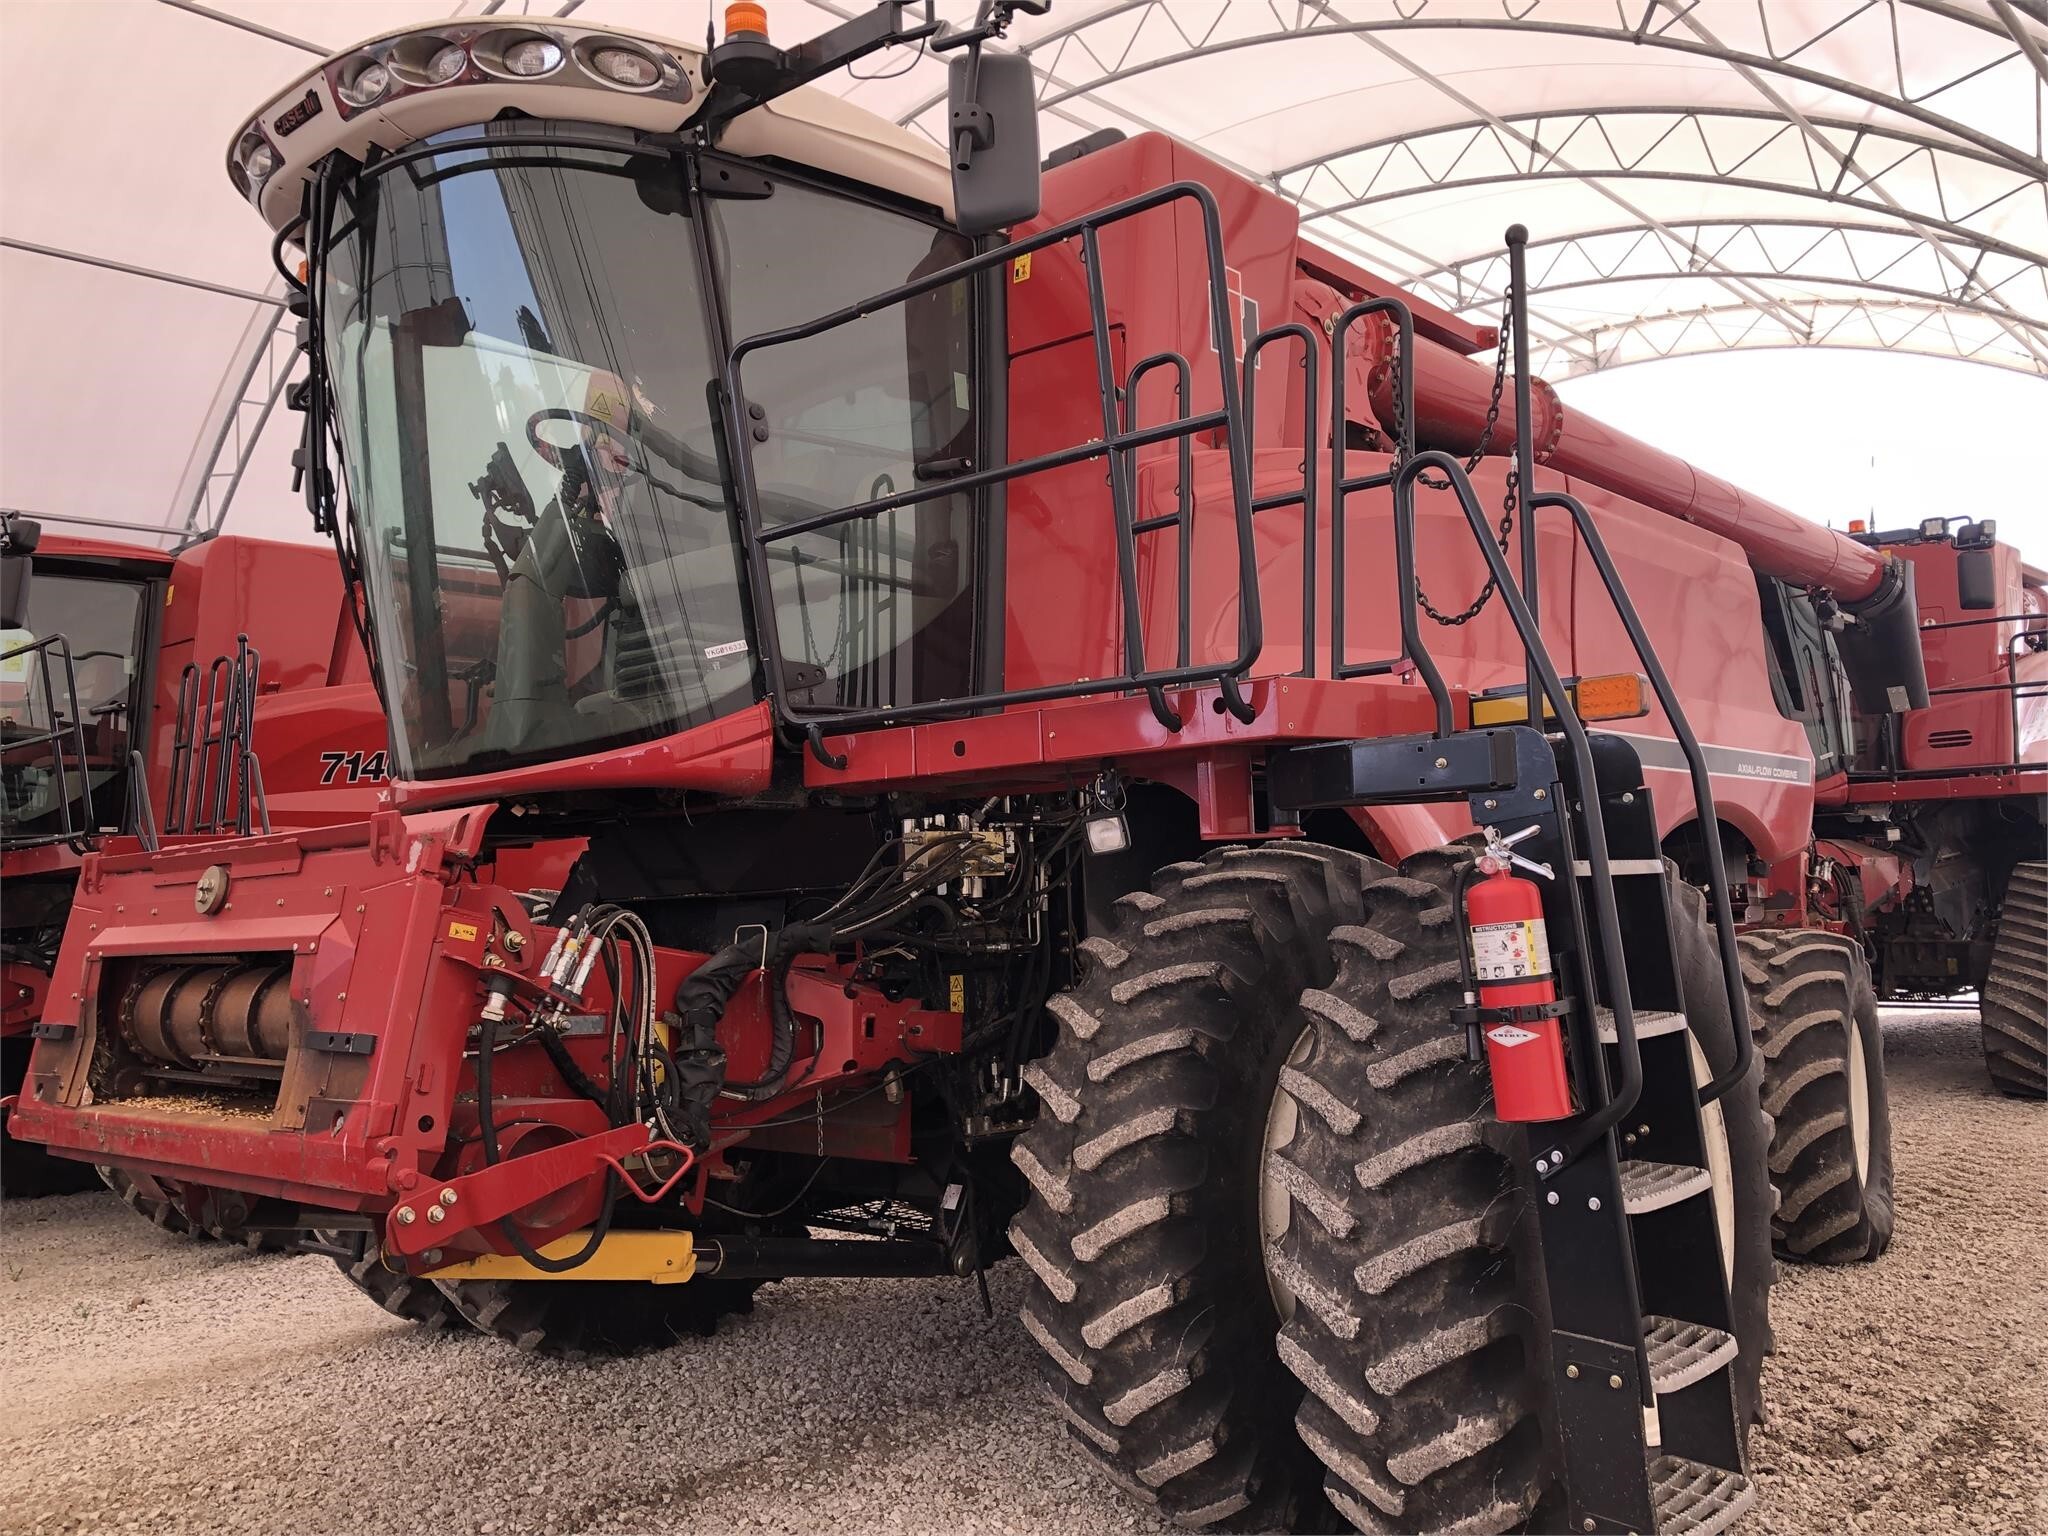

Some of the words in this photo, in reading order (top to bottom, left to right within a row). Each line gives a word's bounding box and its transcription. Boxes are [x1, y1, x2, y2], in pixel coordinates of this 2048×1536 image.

[274, 105, 305, 135] CASE
[320, 751, 393, 784] 714
[1737, 763, 1772, 776] AXIAL-FLOW
[1772, 767, 1798, 779] COMBINE
